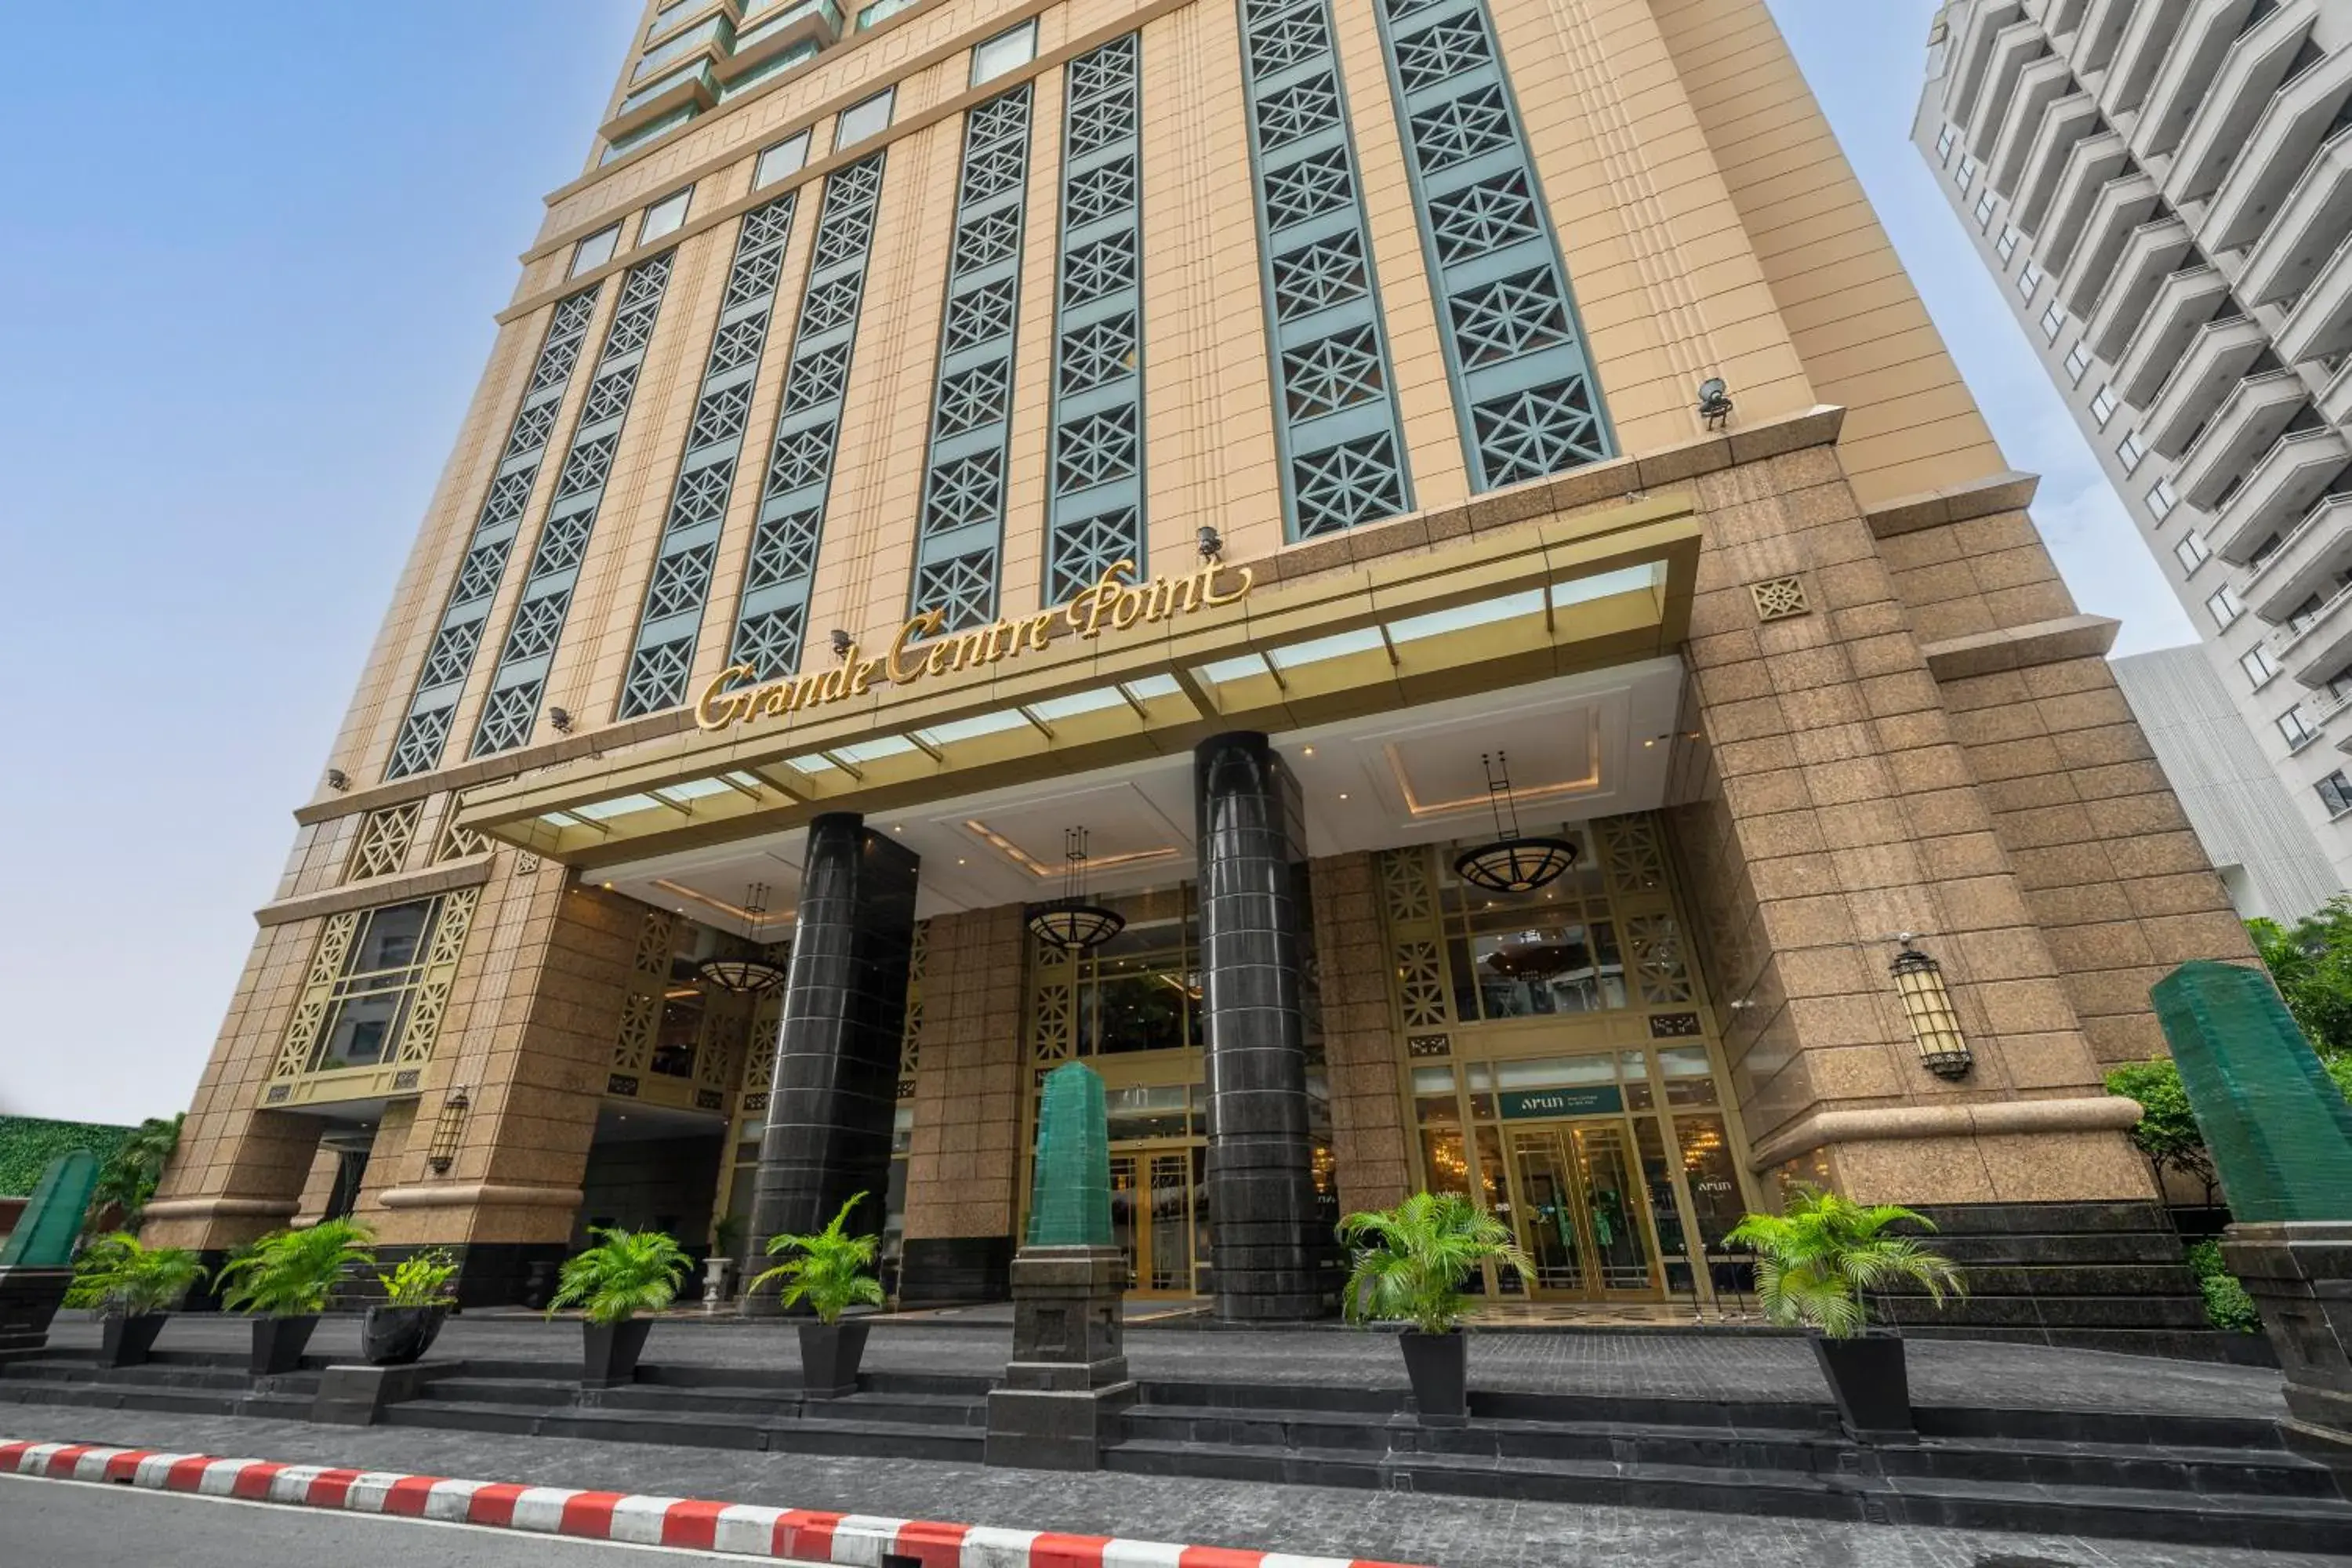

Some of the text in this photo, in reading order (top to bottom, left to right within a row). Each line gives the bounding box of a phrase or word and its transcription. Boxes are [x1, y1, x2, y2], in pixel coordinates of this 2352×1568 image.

[695, 558, 1252, 731] Grande Centre Point
